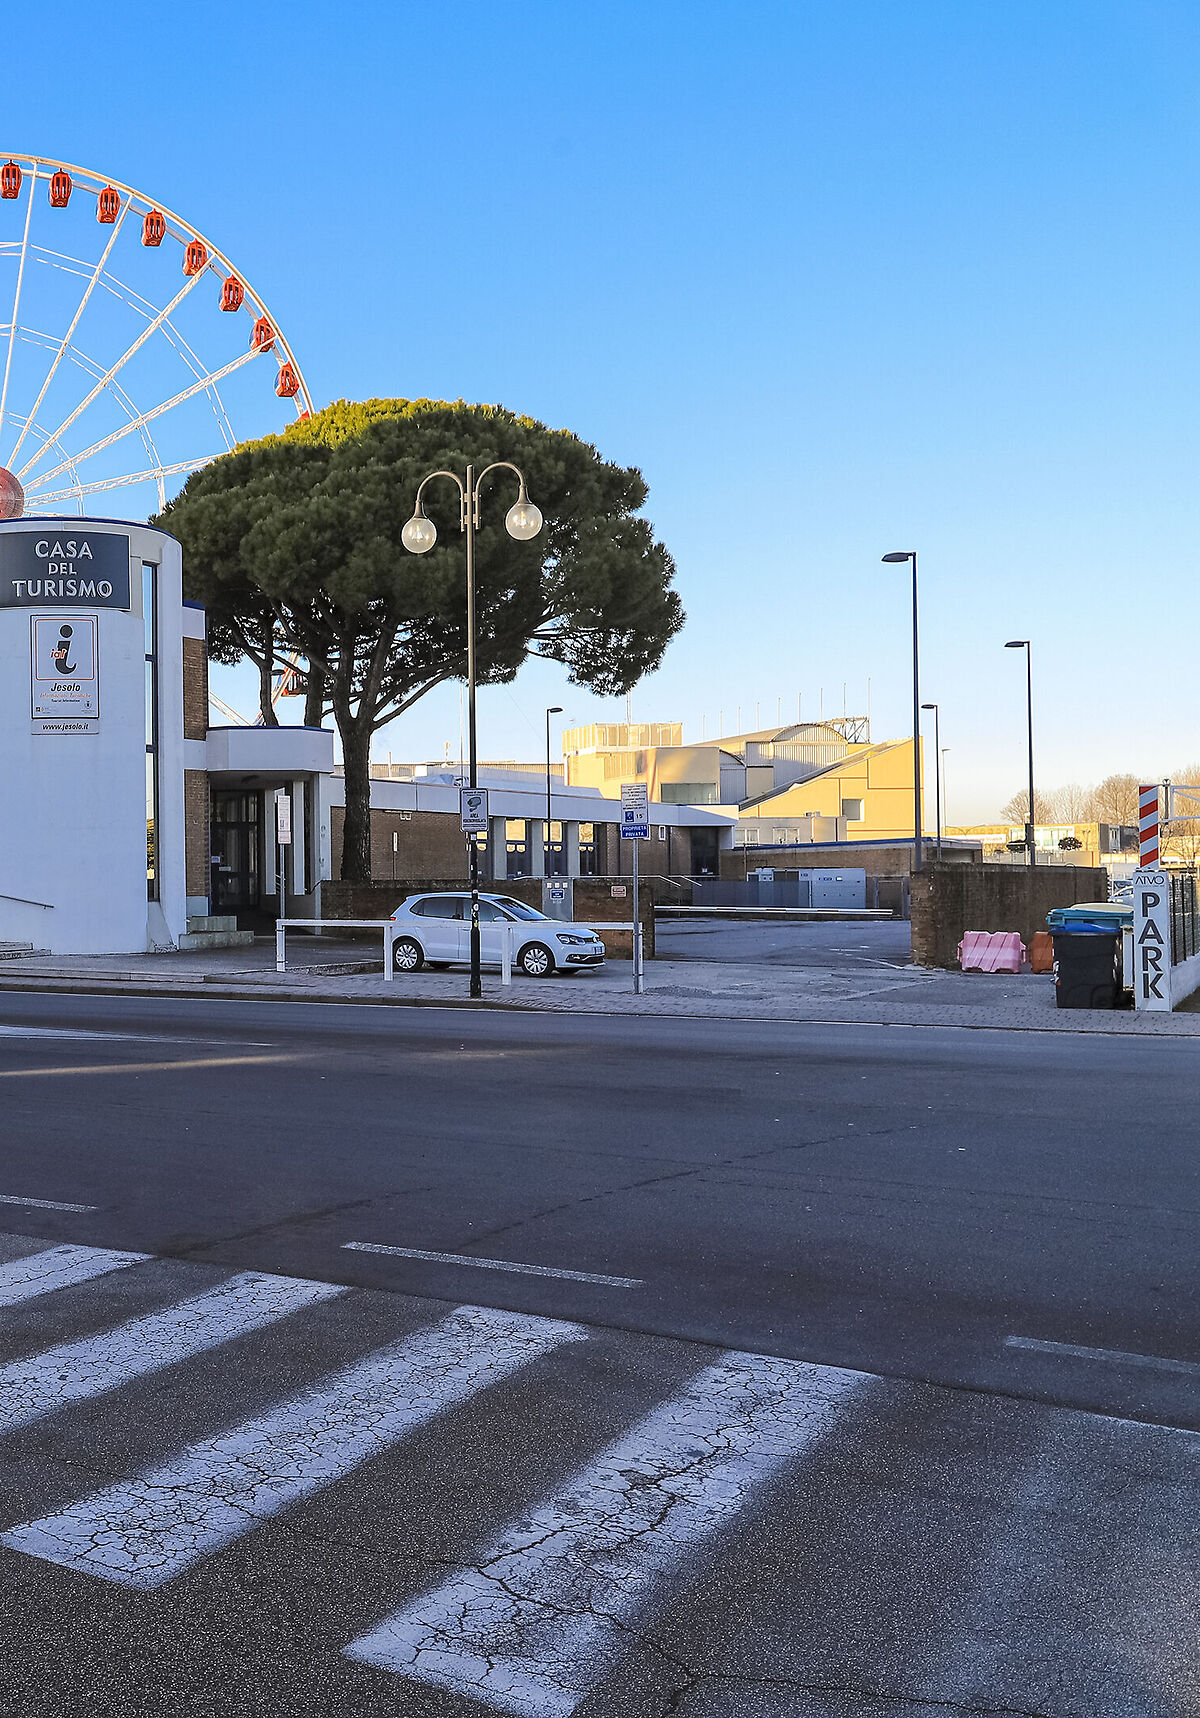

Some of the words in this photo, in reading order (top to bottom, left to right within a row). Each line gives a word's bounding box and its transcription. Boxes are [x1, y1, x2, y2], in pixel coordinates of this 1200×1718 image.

[35, 540, 93, 559] CASA
[48, 563, 77, 575] DEL
[11, 579, 113, 598] TURISMO
[50, 682, 81, 692] Jesolo
[42, 722, 89, 731] www.jesolo.it
[1135, 875, 1165, 885] ATVO
[1138, 892, 1165, 999] PARK
